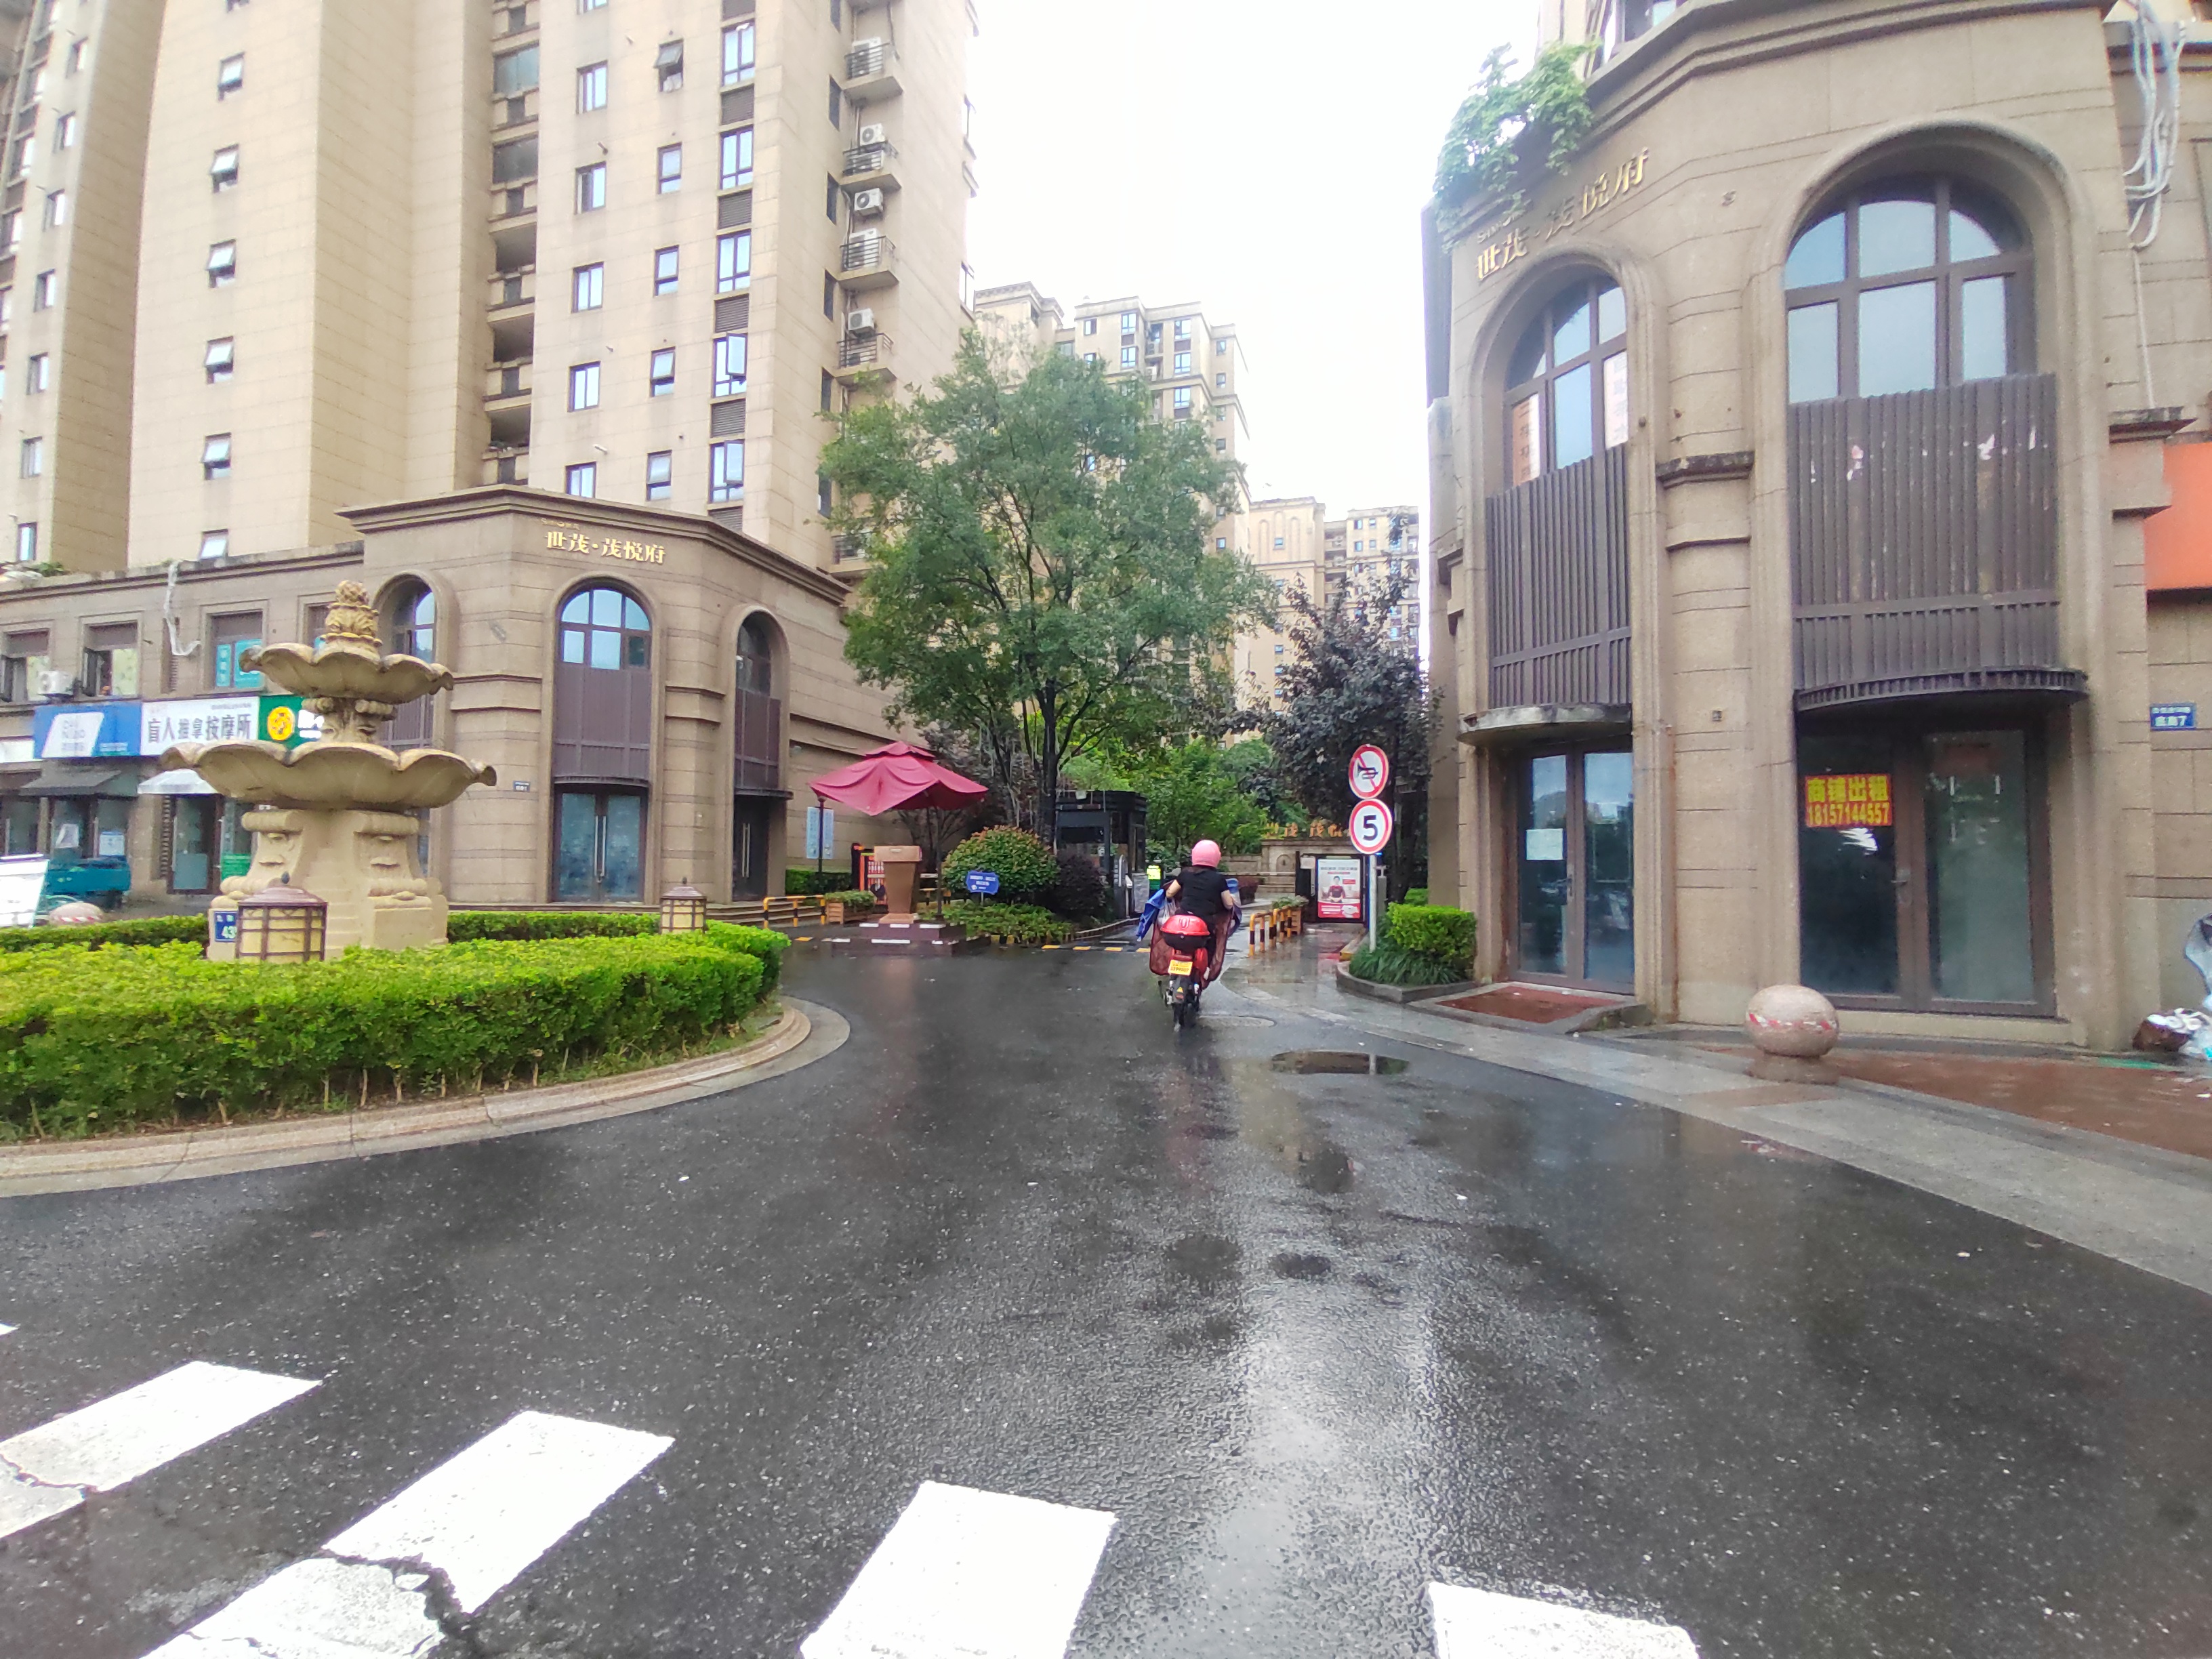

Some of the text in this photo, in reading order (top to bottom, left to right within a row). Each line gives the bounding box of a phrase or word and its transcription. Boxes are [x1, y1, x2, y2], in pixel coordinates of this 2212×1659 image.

[544, 531, 665, 564] 世茂·茂悦府
[1363, 815, 1378, 840] 5
